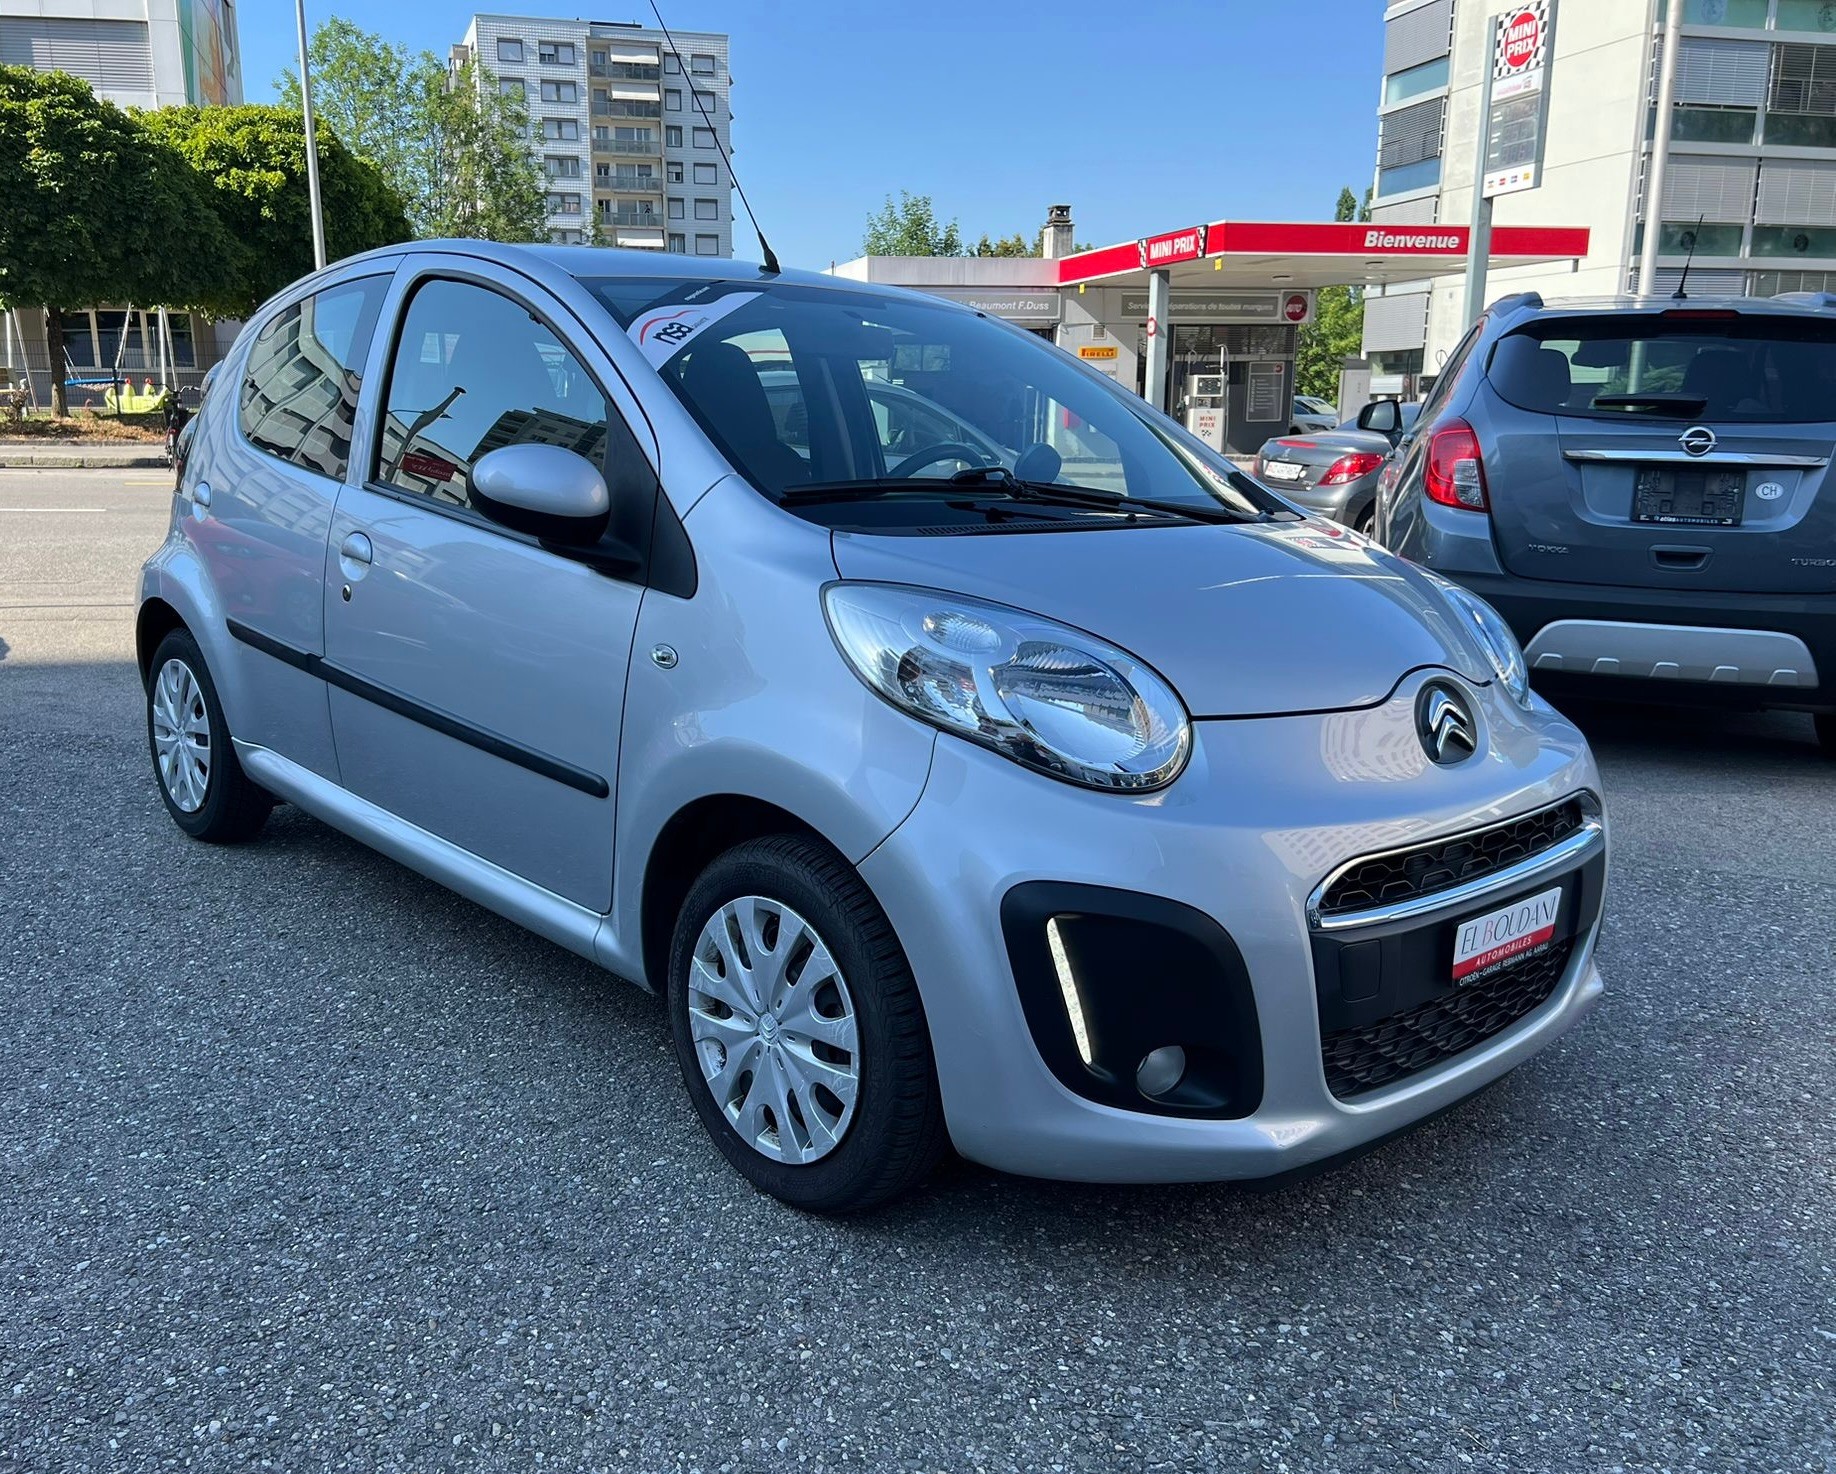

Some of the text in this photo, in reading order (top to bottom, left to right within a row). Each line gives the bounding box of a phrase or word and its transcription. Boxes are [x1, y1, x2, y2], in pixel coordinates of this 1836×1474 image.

[1507, 20, 1536, 42] MINI
[1506, 36, 1536, 58] PRIX
[1150, 234, 1196, 260] MINI PRIX
[1364, 230, 1460, 249] Bienvenue
[1207, 302, 1218, 310] de
[653, 321, 694, 346] nsa
[1761, 485, 1778, 496] CH
[1791, 558, 1836, 567] TURBO
[1461, 925, 1479, 956] EL
[1475, 935, 1533, 967] AUTOMOBILES
